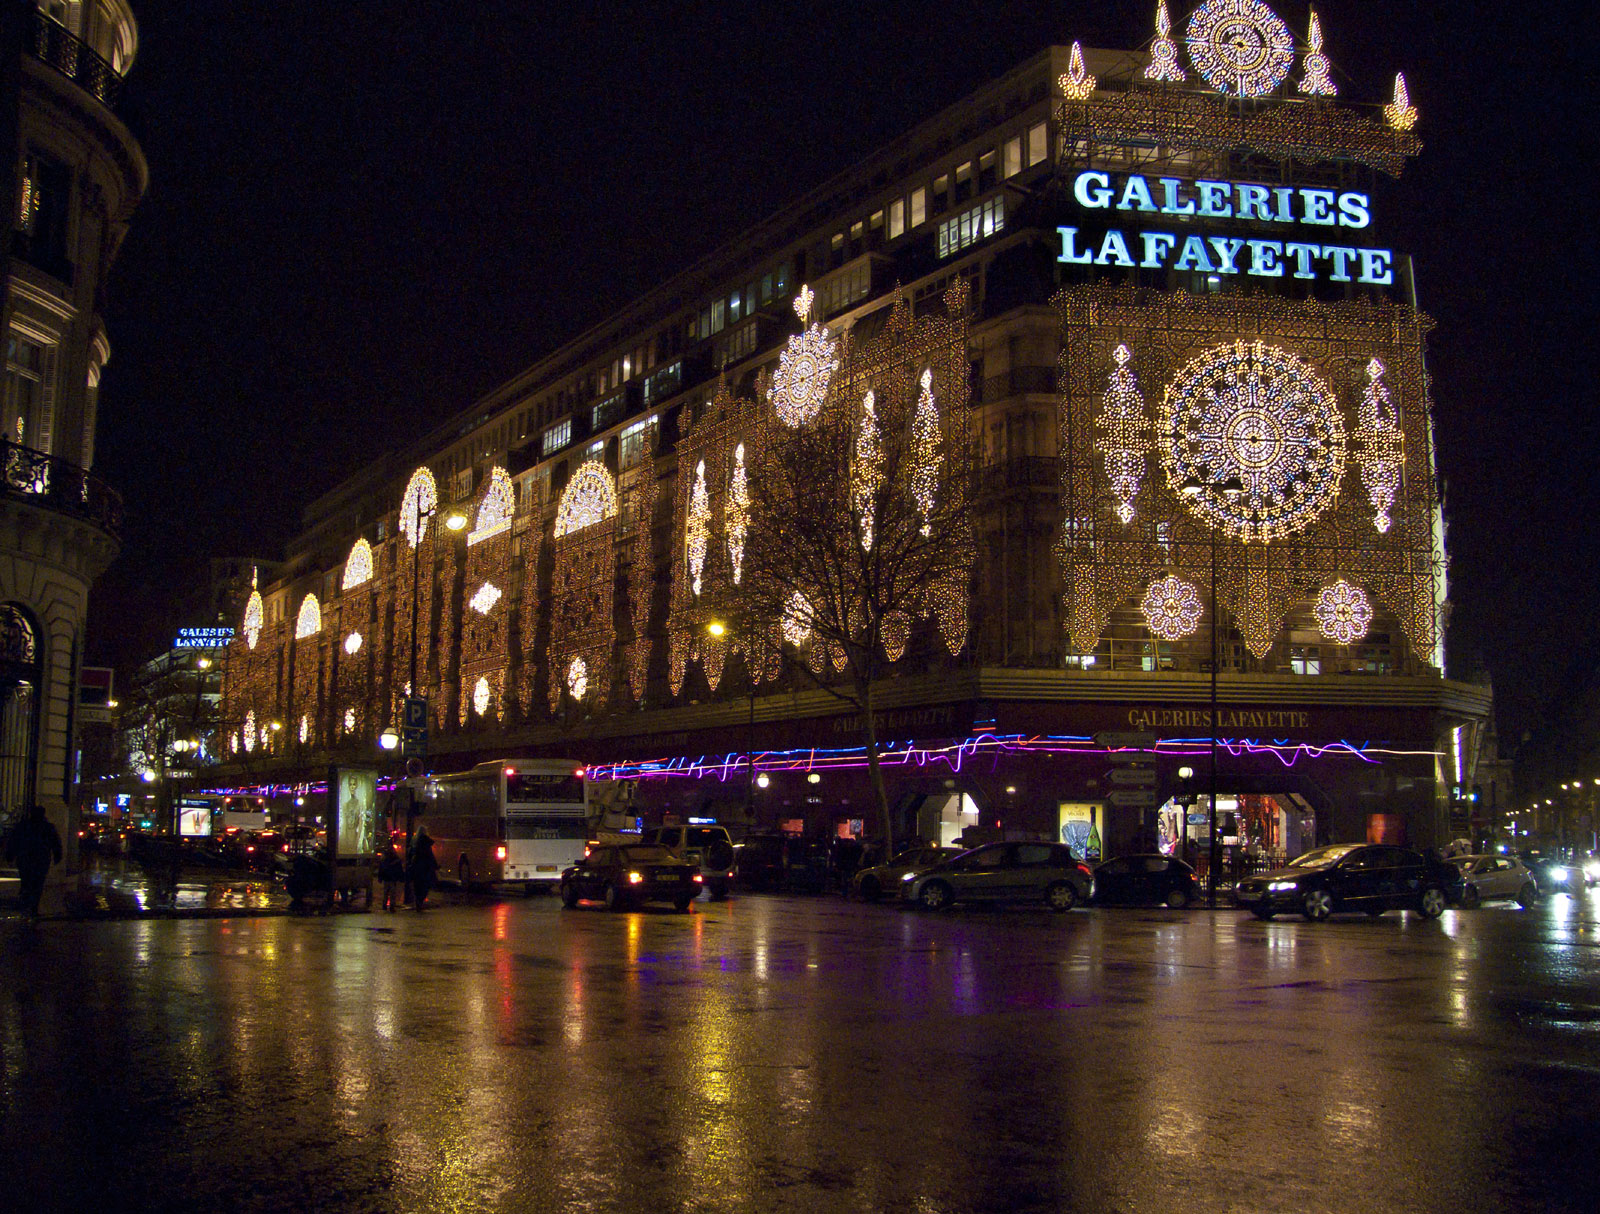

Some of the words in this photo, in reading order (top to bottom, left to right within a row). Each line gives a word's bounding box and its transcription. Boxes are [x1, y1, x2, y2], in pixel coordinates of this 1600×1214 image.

[1073, 170, 1371, 229] GALERIES
[1055, 225, 1394, 285] LAFAYETTE
[1128, 709, 1212, 727] GALERIES
[1216, 711, 1310, 728] LAFAYETTE
